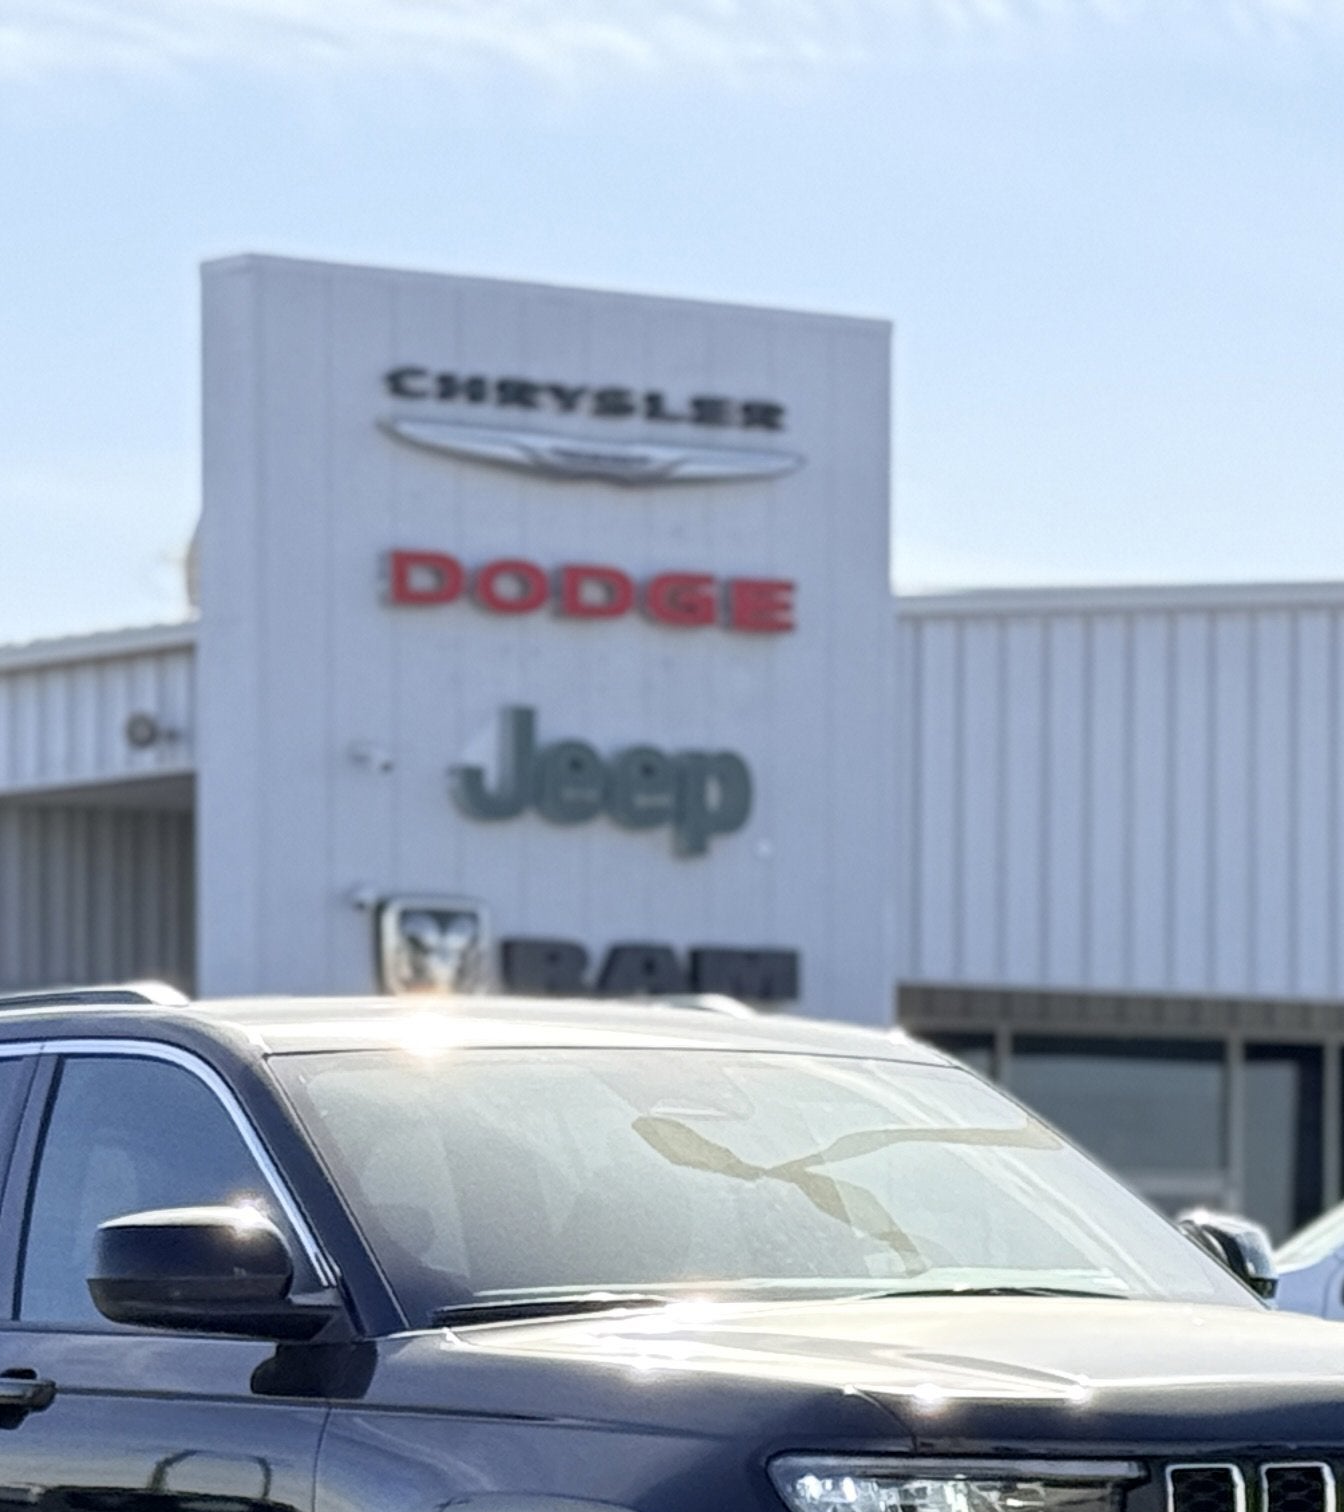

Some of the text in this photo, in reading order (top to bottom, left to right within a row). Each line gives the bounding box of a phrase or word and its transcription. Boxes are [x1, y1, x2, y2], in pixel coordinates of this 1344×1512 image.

[385, 367, 786, 431] CHRYSLER
[382, 548, 796, 633] DODGE
[448, 706, 753, 858] Jeep
[501, 938, 800, 1002] RAM
